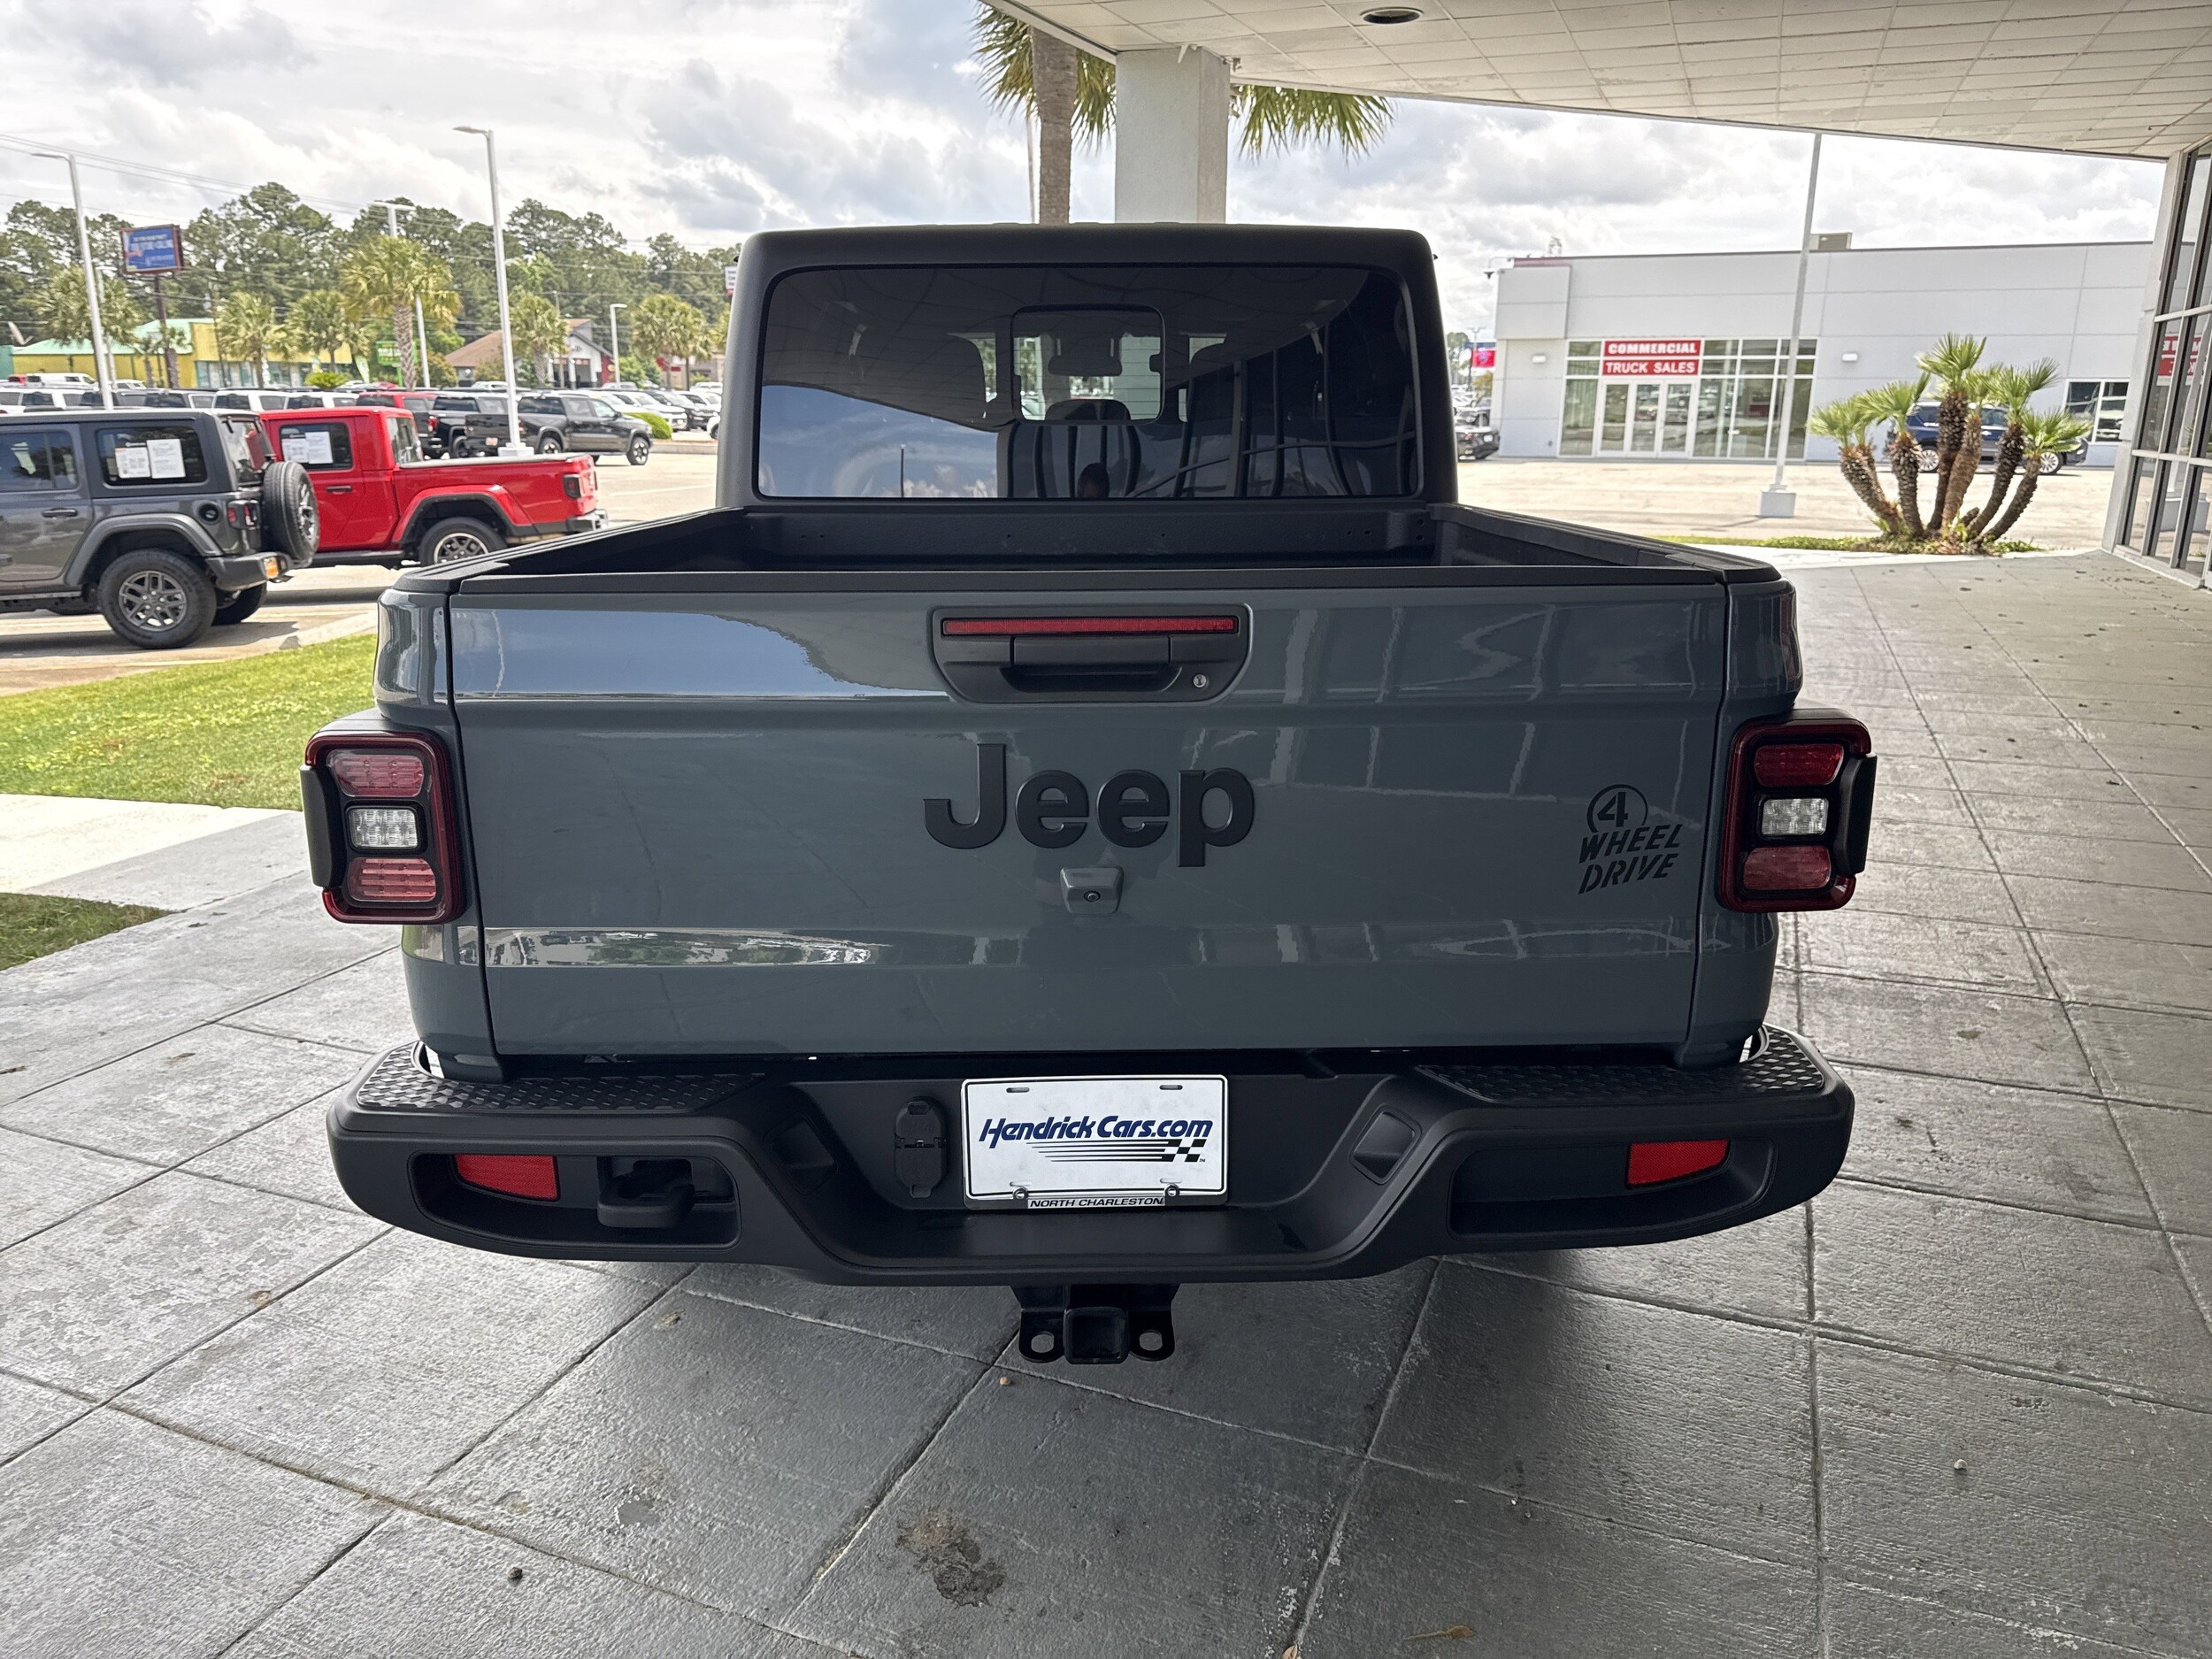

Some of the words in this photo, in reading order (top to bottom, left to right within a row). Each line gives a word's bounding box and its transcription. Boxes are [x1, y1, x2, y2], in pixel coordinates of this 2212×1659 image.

[1608, 342, 1697, 354] COMMERCIAL
[1605, 362, 1649, 373] TRUCK
[1653, 362, 1695, 373] SALES
[923, 743, 1255, 867] Jeep
[1596, 791, 1629, 827] 4
[1578, 824, 1682, 864] WHEEL
[1578, 853, 1679, 895] DRIVE
[1029, 1199, 1076, 1208] NORTH
[1078, 1197, 1165, 1207] CHARLESTON
